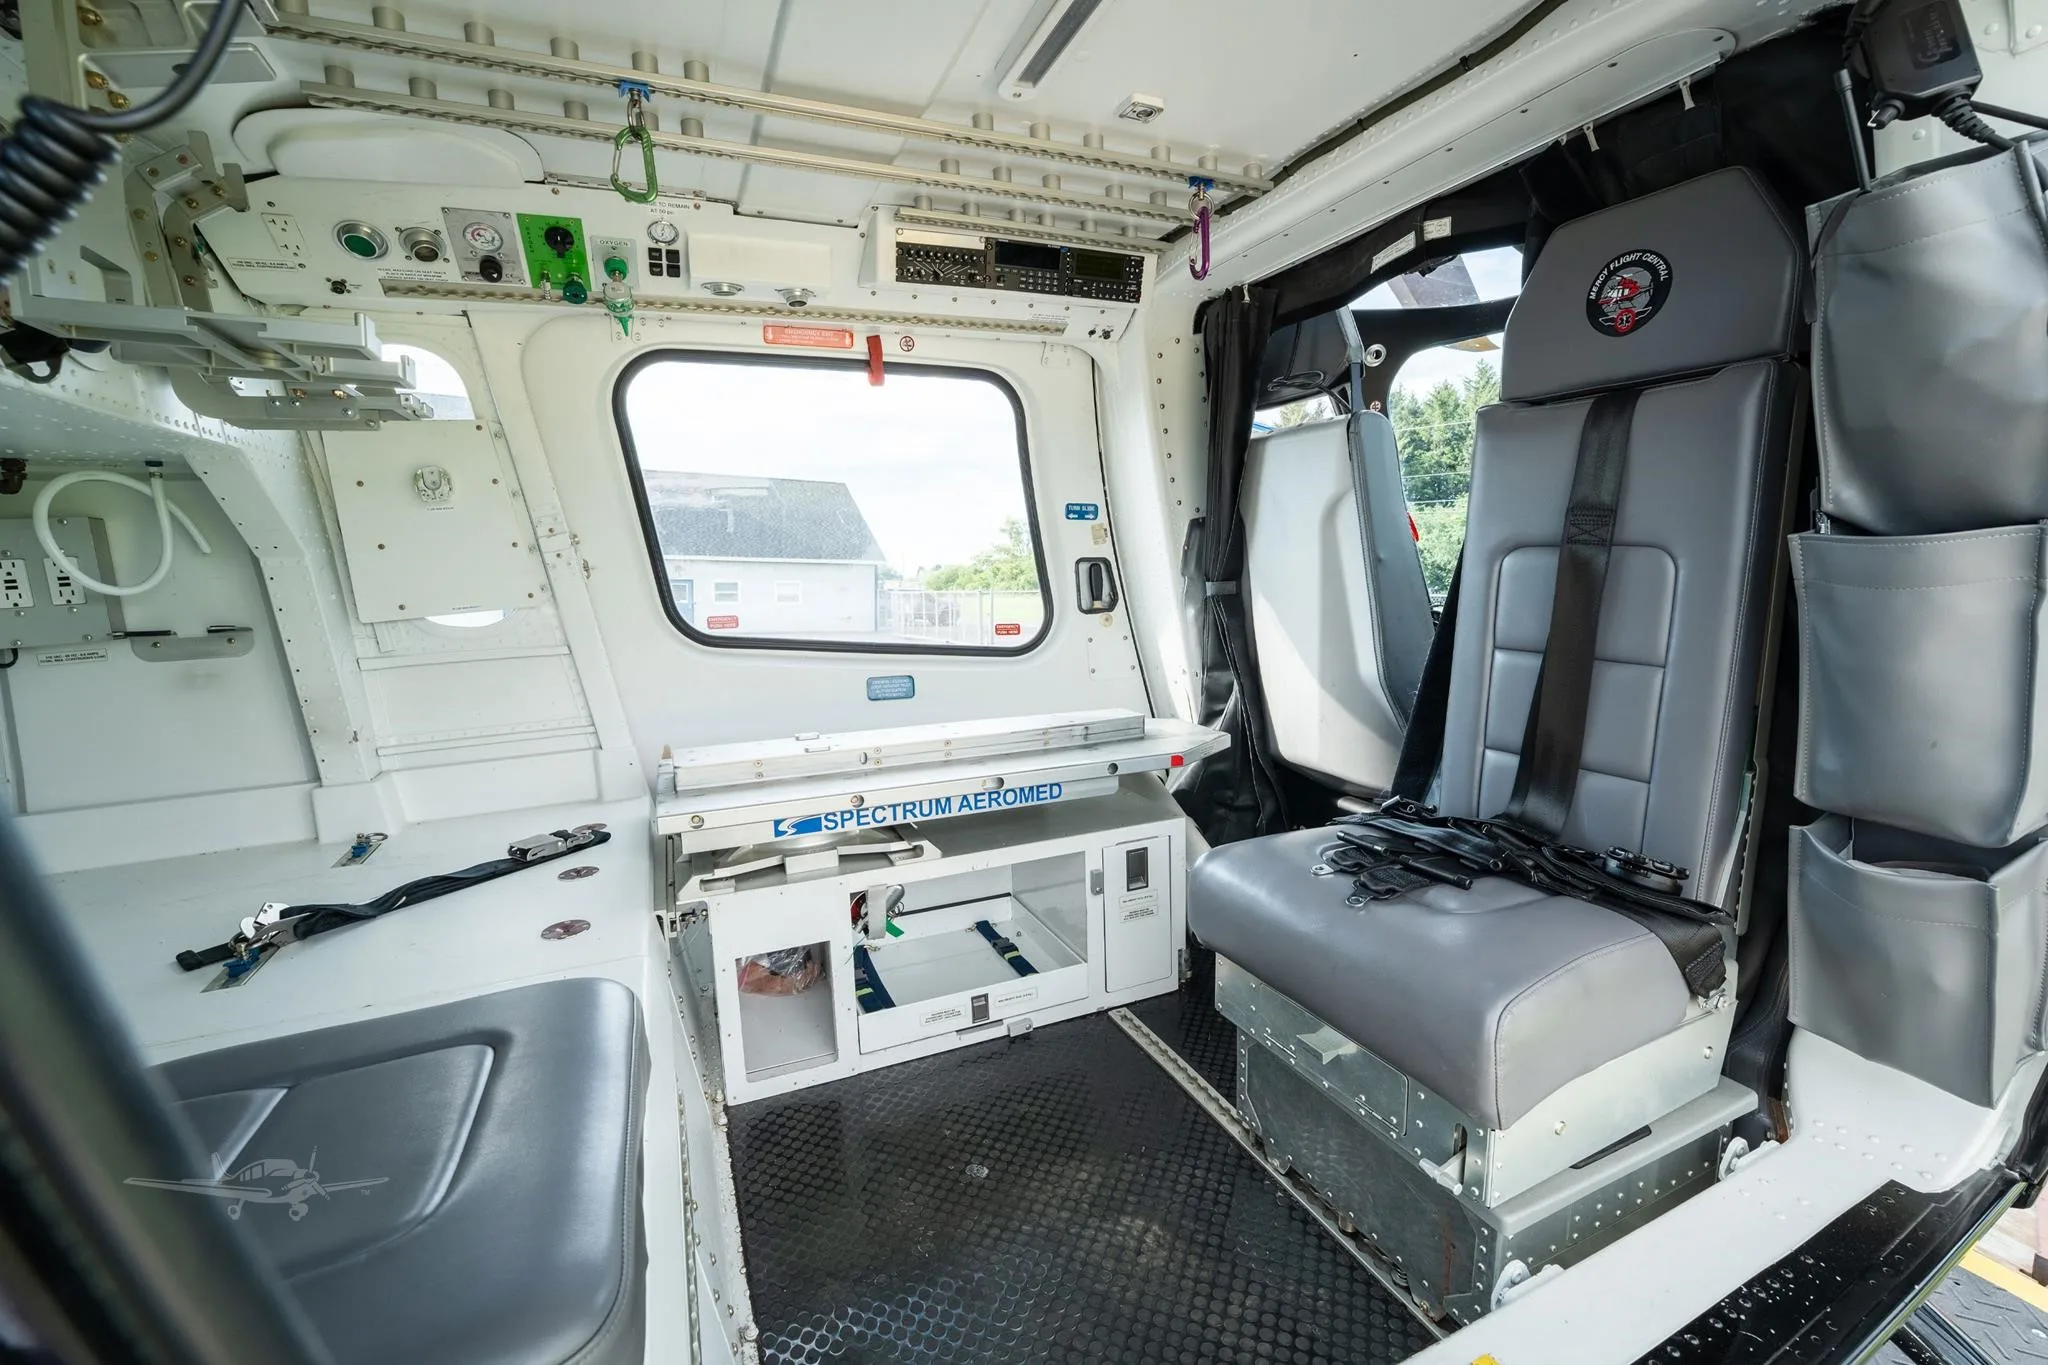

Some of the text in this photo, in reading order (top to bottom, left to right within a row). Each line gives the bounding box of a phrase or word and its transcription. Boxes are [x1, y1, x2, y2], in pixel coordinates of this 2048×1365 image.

[667, 202, 690, 210] REMAIN
[599, 239, 629, 247] OXYGEN
[1589, 252, 1670, 300] MERCY FLIGHT CENTRAL
[823, 782, 1063, 831] SPECTRUM AEROMED
